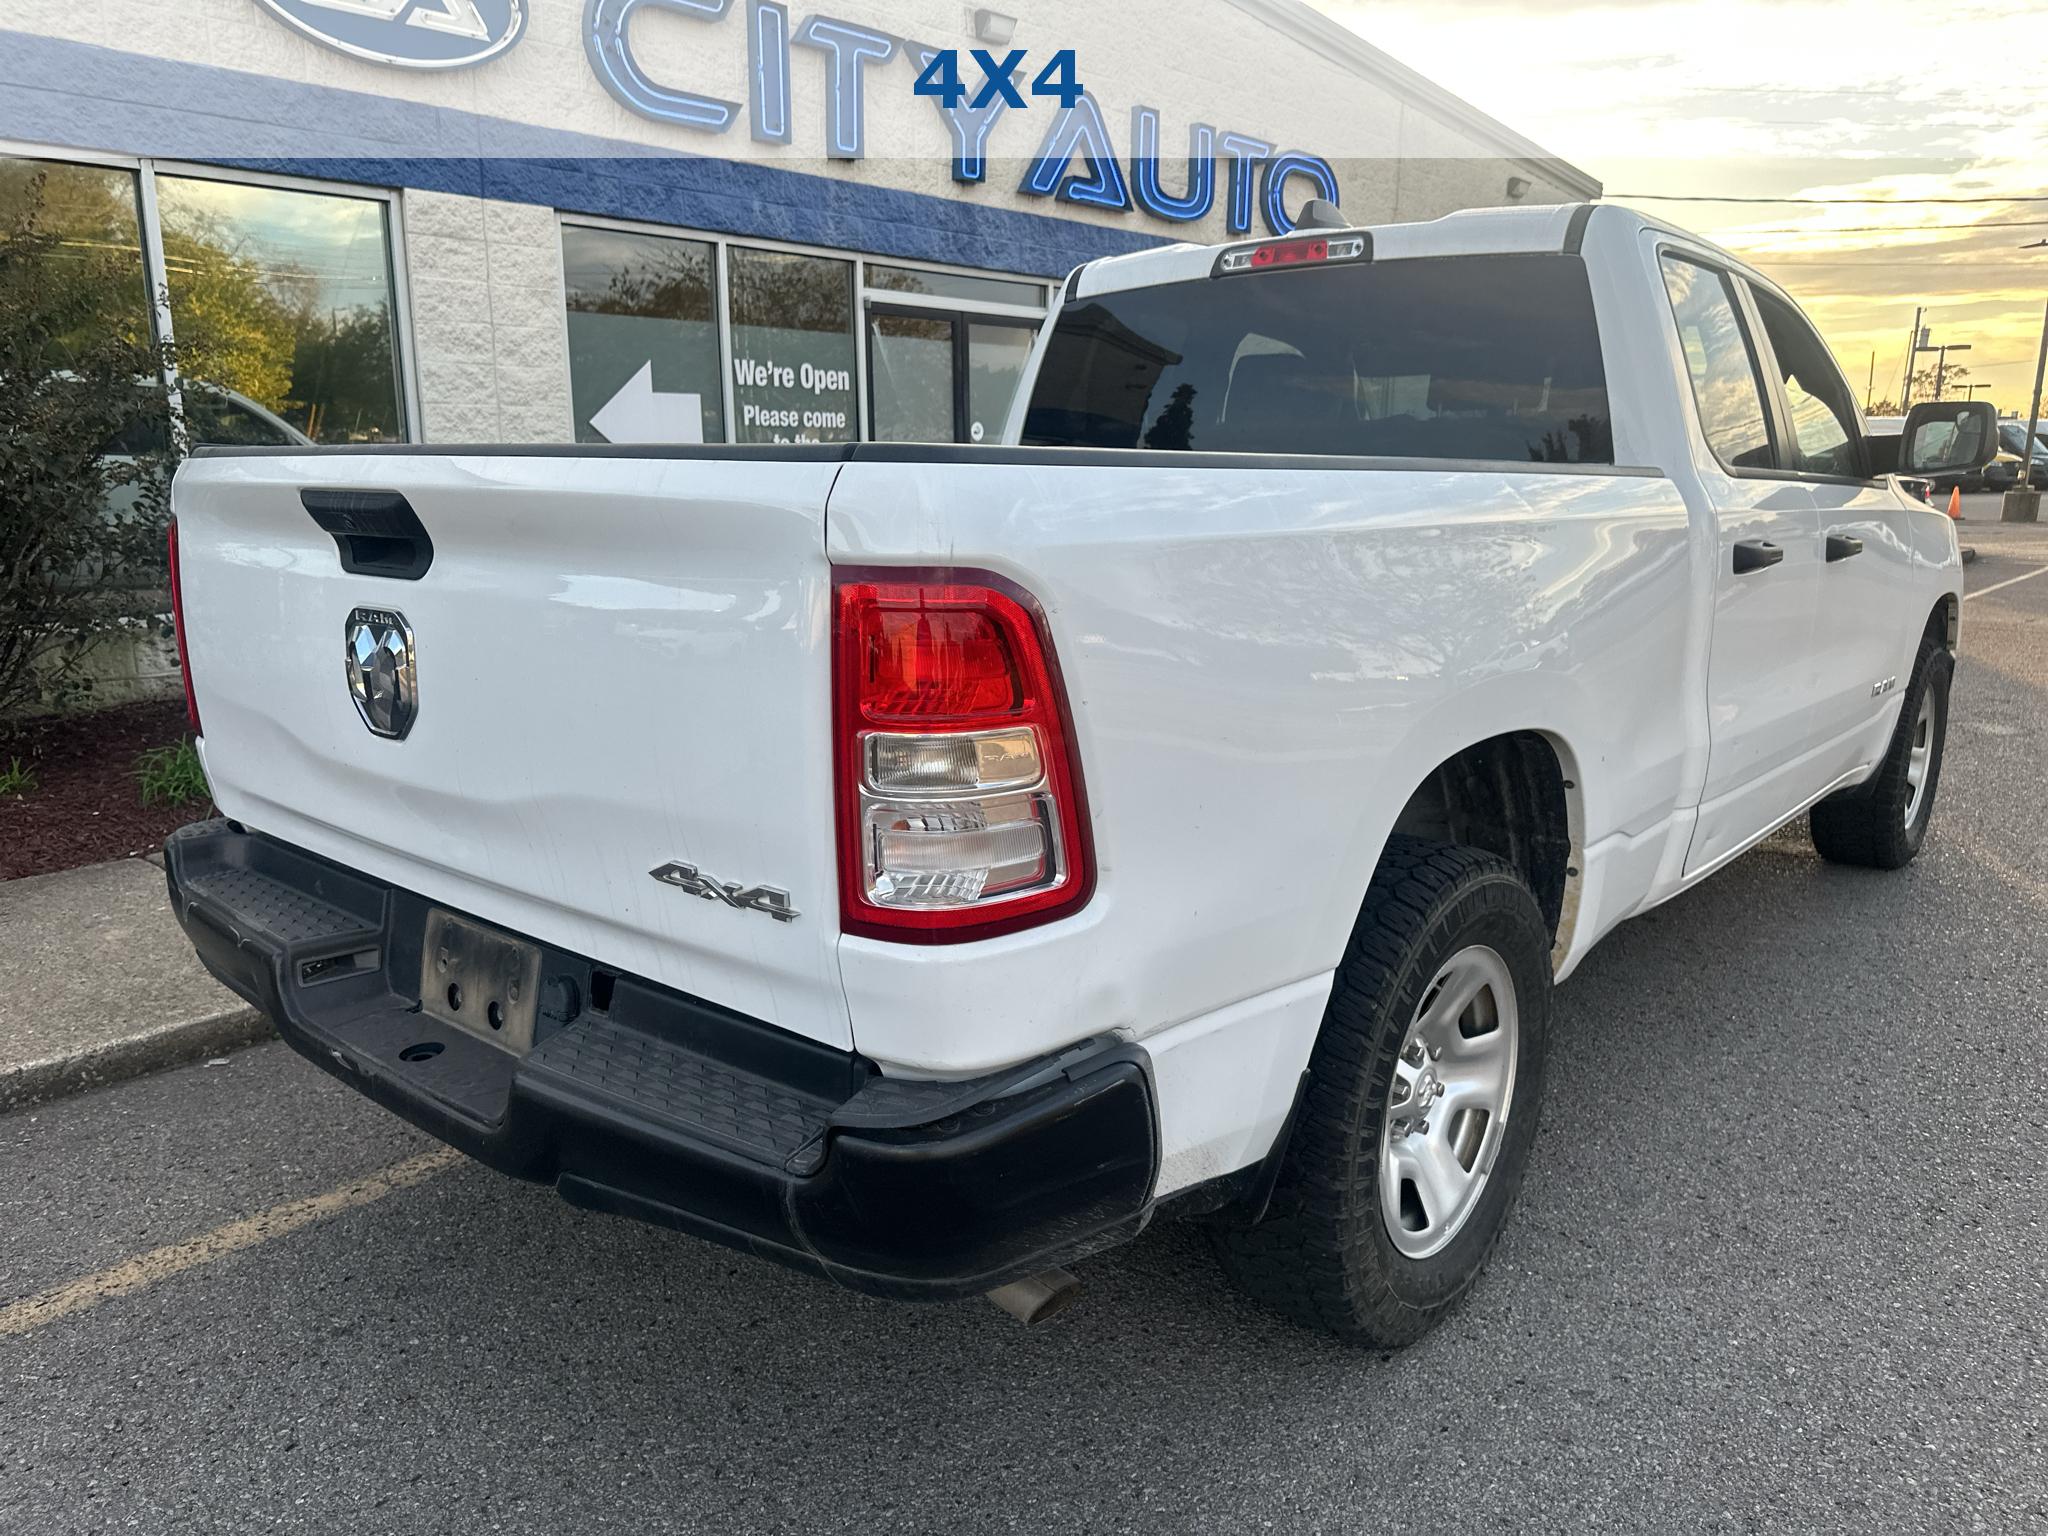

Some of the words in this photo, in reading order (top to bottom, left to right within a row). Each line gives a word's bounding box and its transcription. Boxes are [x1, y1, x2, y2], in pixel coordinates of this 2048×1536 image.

[583, 0, 1026, 184] CITY
[1018, 90, 1341, 237] AUTO
[734, 359, 794, 389] We're
[800, 362, 850, 394] Open
[744, 405, 799, 428] Please
[803, 410, 846, 429] come
